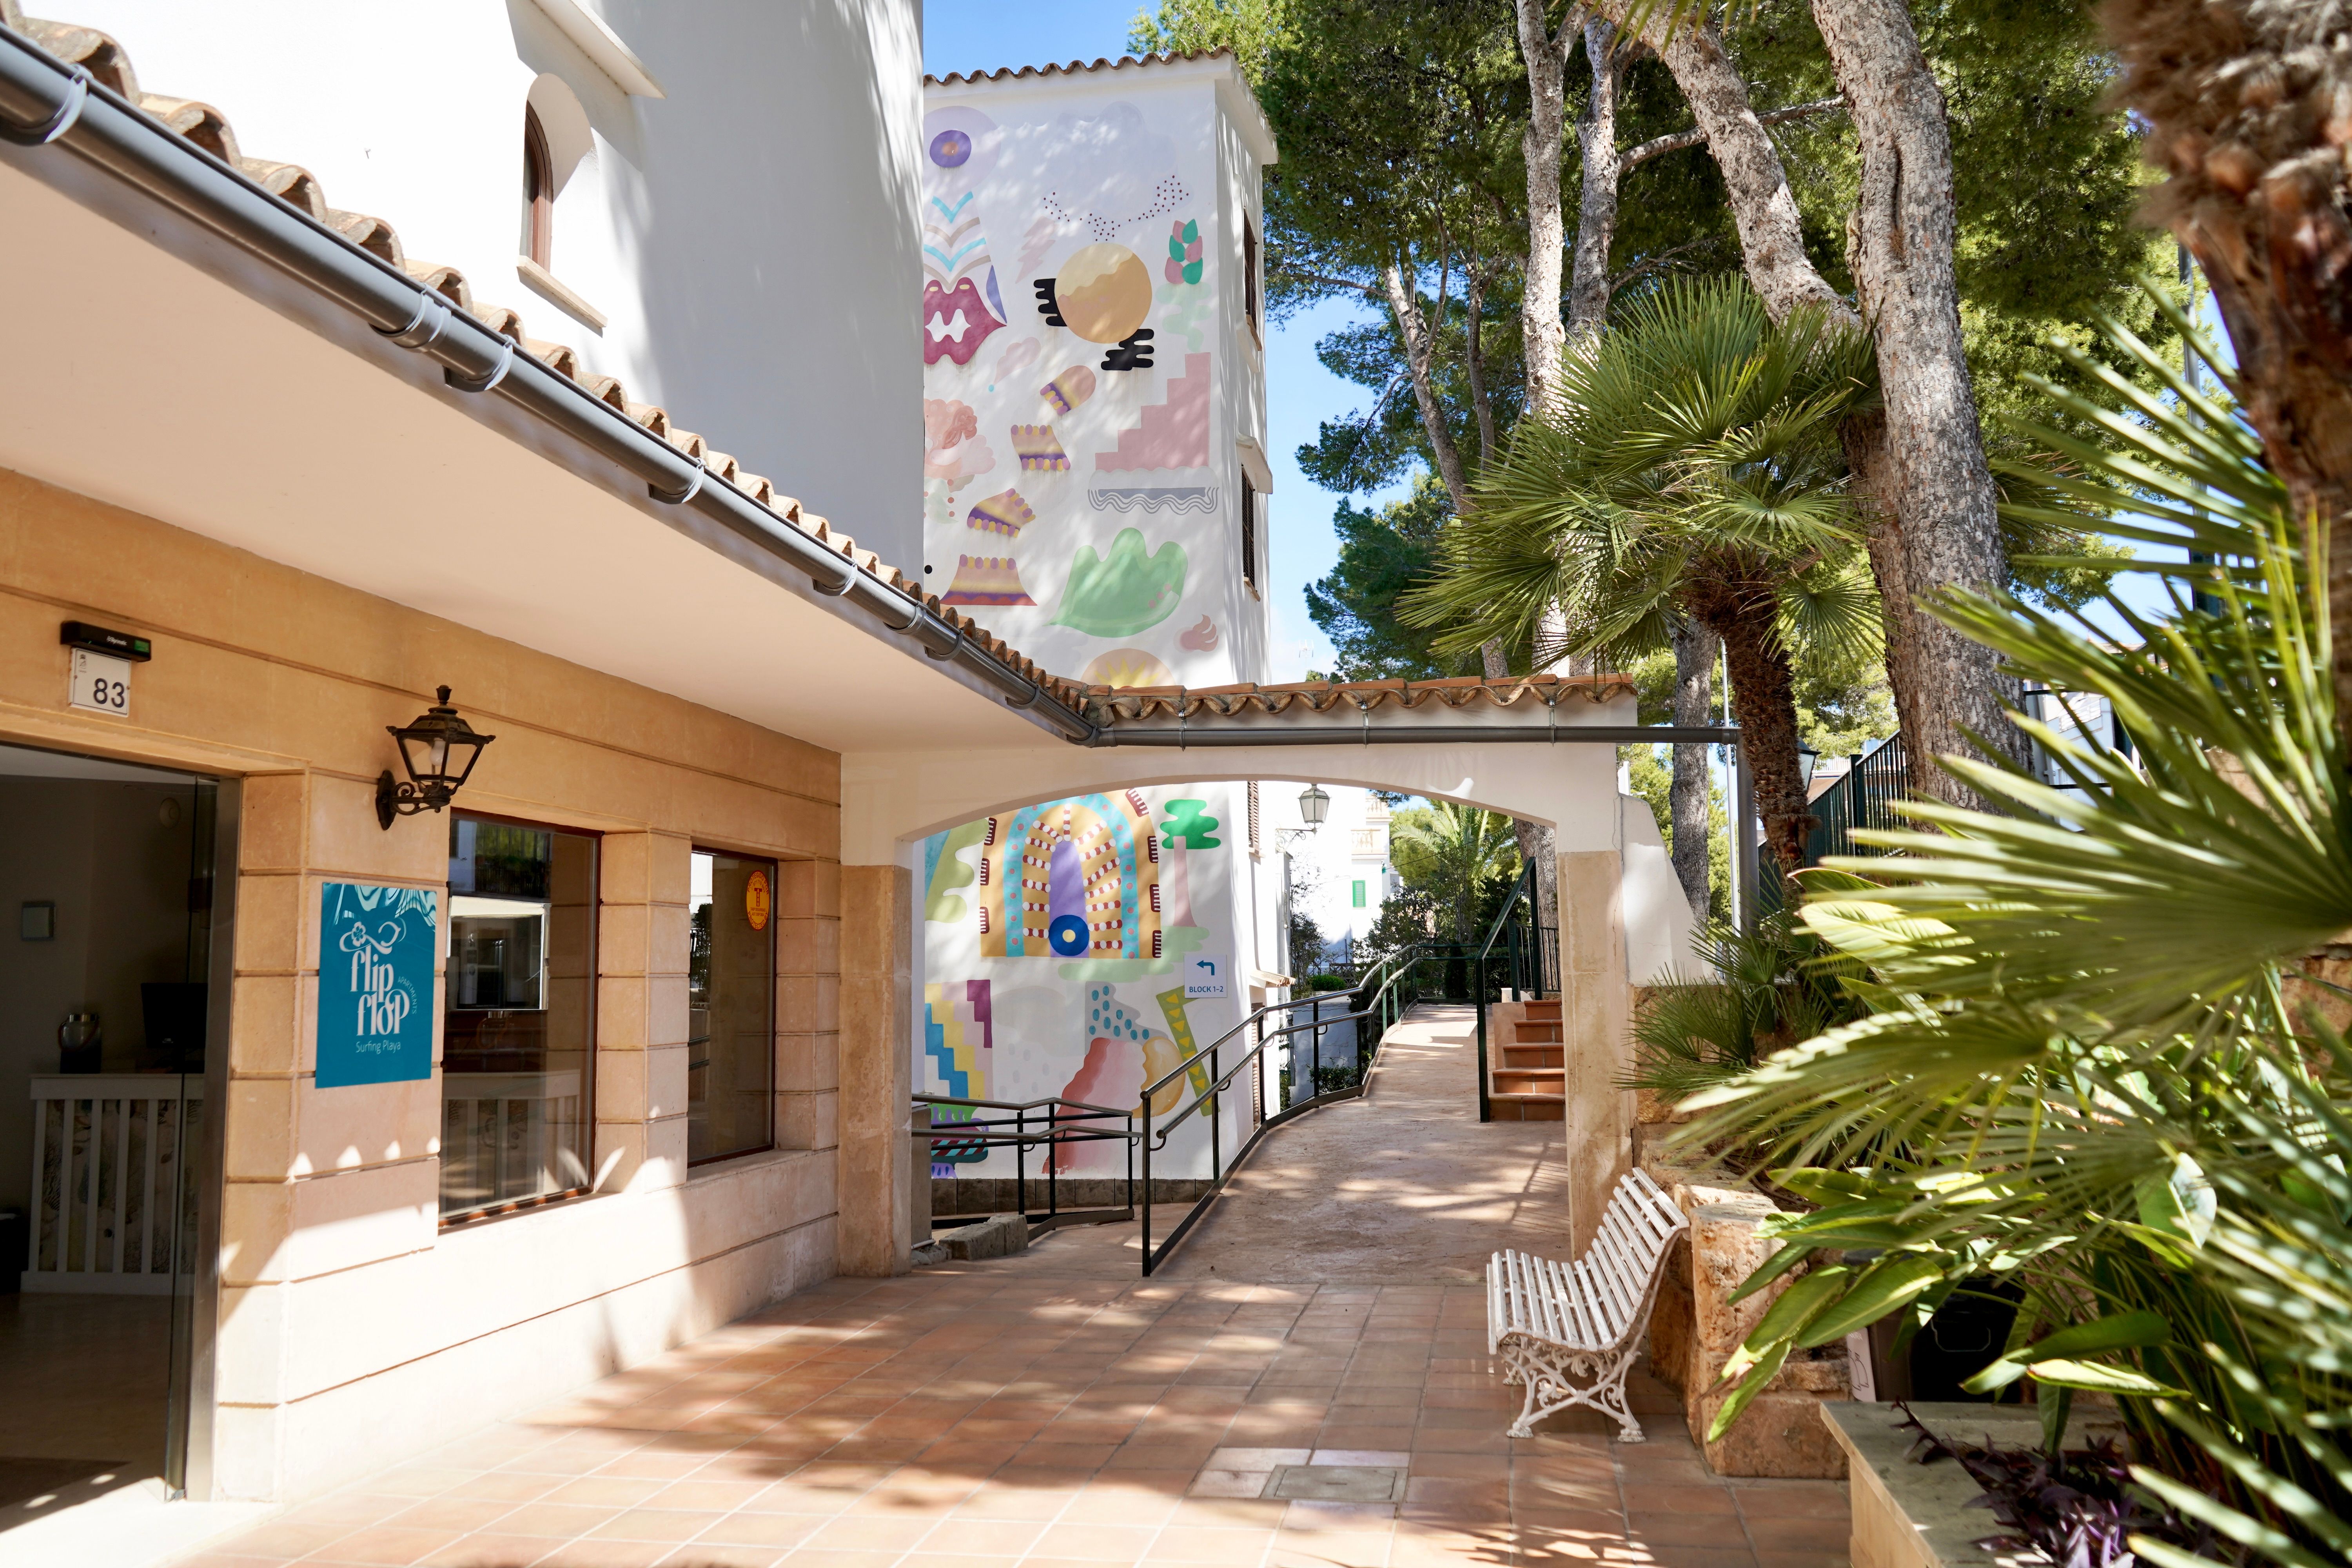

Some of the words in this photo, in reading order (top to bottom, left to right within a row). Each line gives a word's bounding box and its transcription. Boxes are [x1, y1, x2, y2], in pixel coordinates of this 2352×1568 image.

[93, 678, 125, 708] 83
[747, 872, 764, 893] PROTEGIDO
[748, 911, 765, 929] PROTECTED
[350, 944, 394, 1002] flip
[397, 976, 417, 1014] APARTMENTS
[356, 1040, 381, 1054] Surfing
[383, 1040, 401, 1054] Playa
